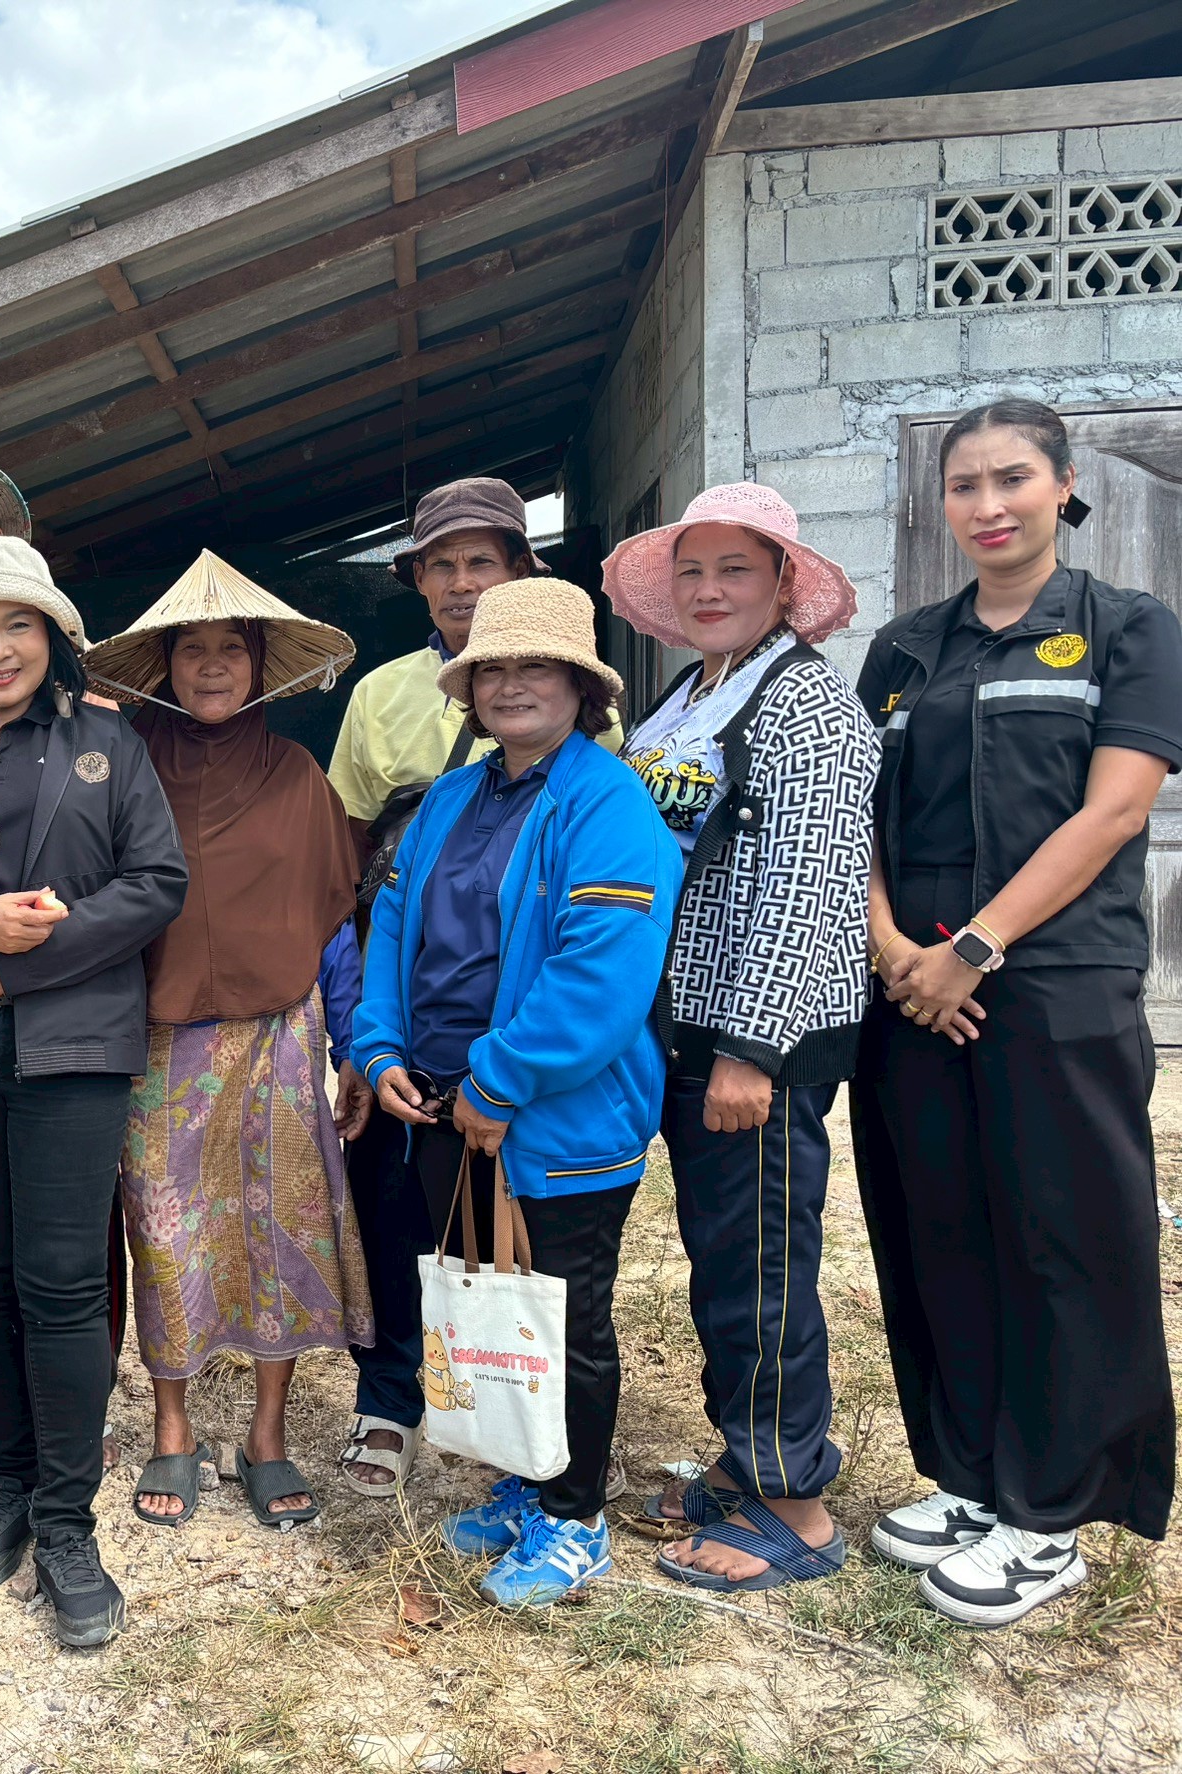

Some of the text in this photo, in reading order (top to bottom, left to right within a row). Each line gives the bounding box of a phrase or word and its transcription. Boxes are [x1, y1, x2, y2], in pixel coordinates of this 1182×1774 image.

[361, 844, 395, 888] SPORT
[451, 1347, 548, 1373] CREAMKITTEN
[491, 1375, 504, 1383] LOVE
